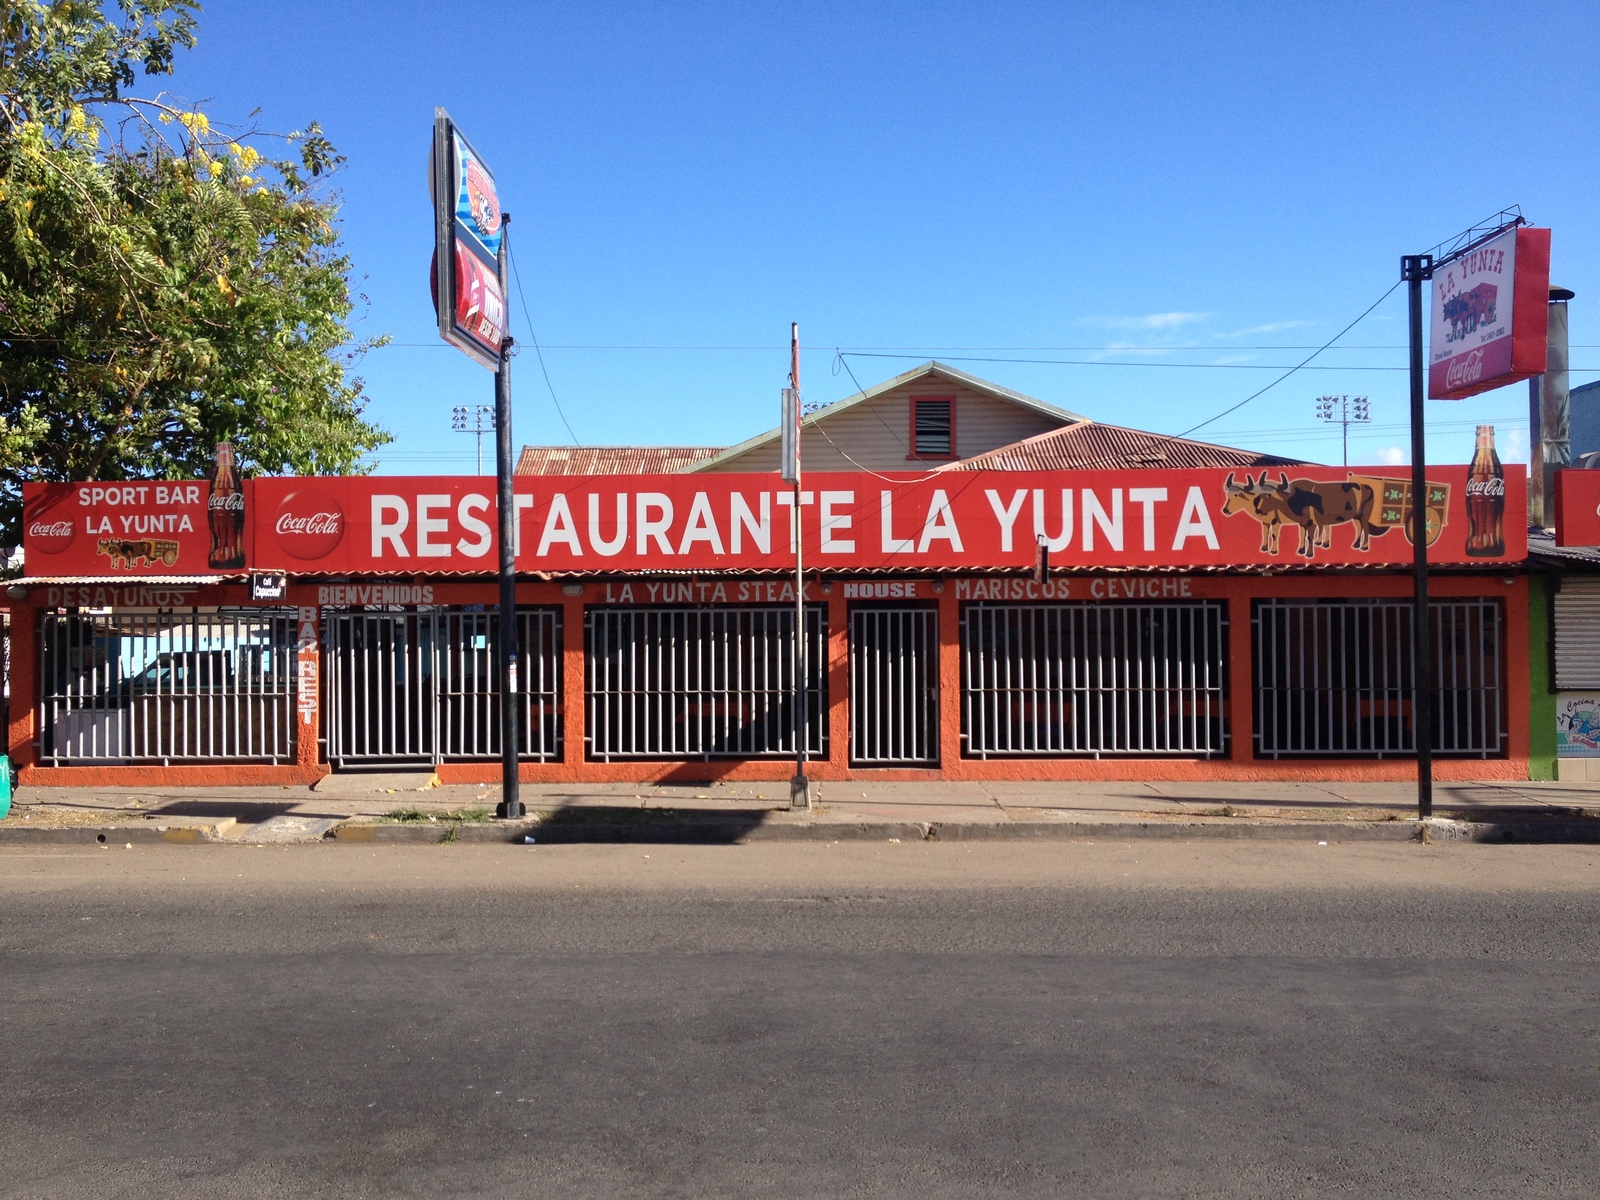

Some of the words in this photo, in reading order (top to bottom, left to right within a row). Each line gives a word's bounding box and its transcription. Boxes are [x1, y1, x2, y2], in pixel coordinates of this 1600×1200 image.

[1439, 271, 1455, 301] LA
[1461, 249, 1504, 279] YUNTA
[79, 486, 149, 506] SPORT
[156, 486, 200, 504] BAR
[1466, 477, 1505, 496] Coca-Cola
[208, 492, 245, 511] Coca-Cola
[29, 521, 73, 537] Coca-Cola
[86, 516, 114, 534] LA
[120, 514, 194, 533] YUNTA
[275, 512, 342, 535] Coca-Cola
[371, 490, 856, 557] RESTAURANTE
[880, 489, 965, 553] LA
[984, 486, 1221, 553] YUNTA
[48, 586, 185, 607] DESAYUNOS
[318, 585, 434, 605] BIENVENIDOS
[606, 583, 635, 602] LA
[646, 582, 728, 602] YUNTA
[737, 580, 812, 602] STEAK
[843, 582, 917, 599] HOUSE
[955, 578, 1070, 600] MARISCOS
[1090, 577, 1193, 598] CEVICHE
[298, 606, 317, 653] BAR
[1567, 699, 1595, 712] Cocina
